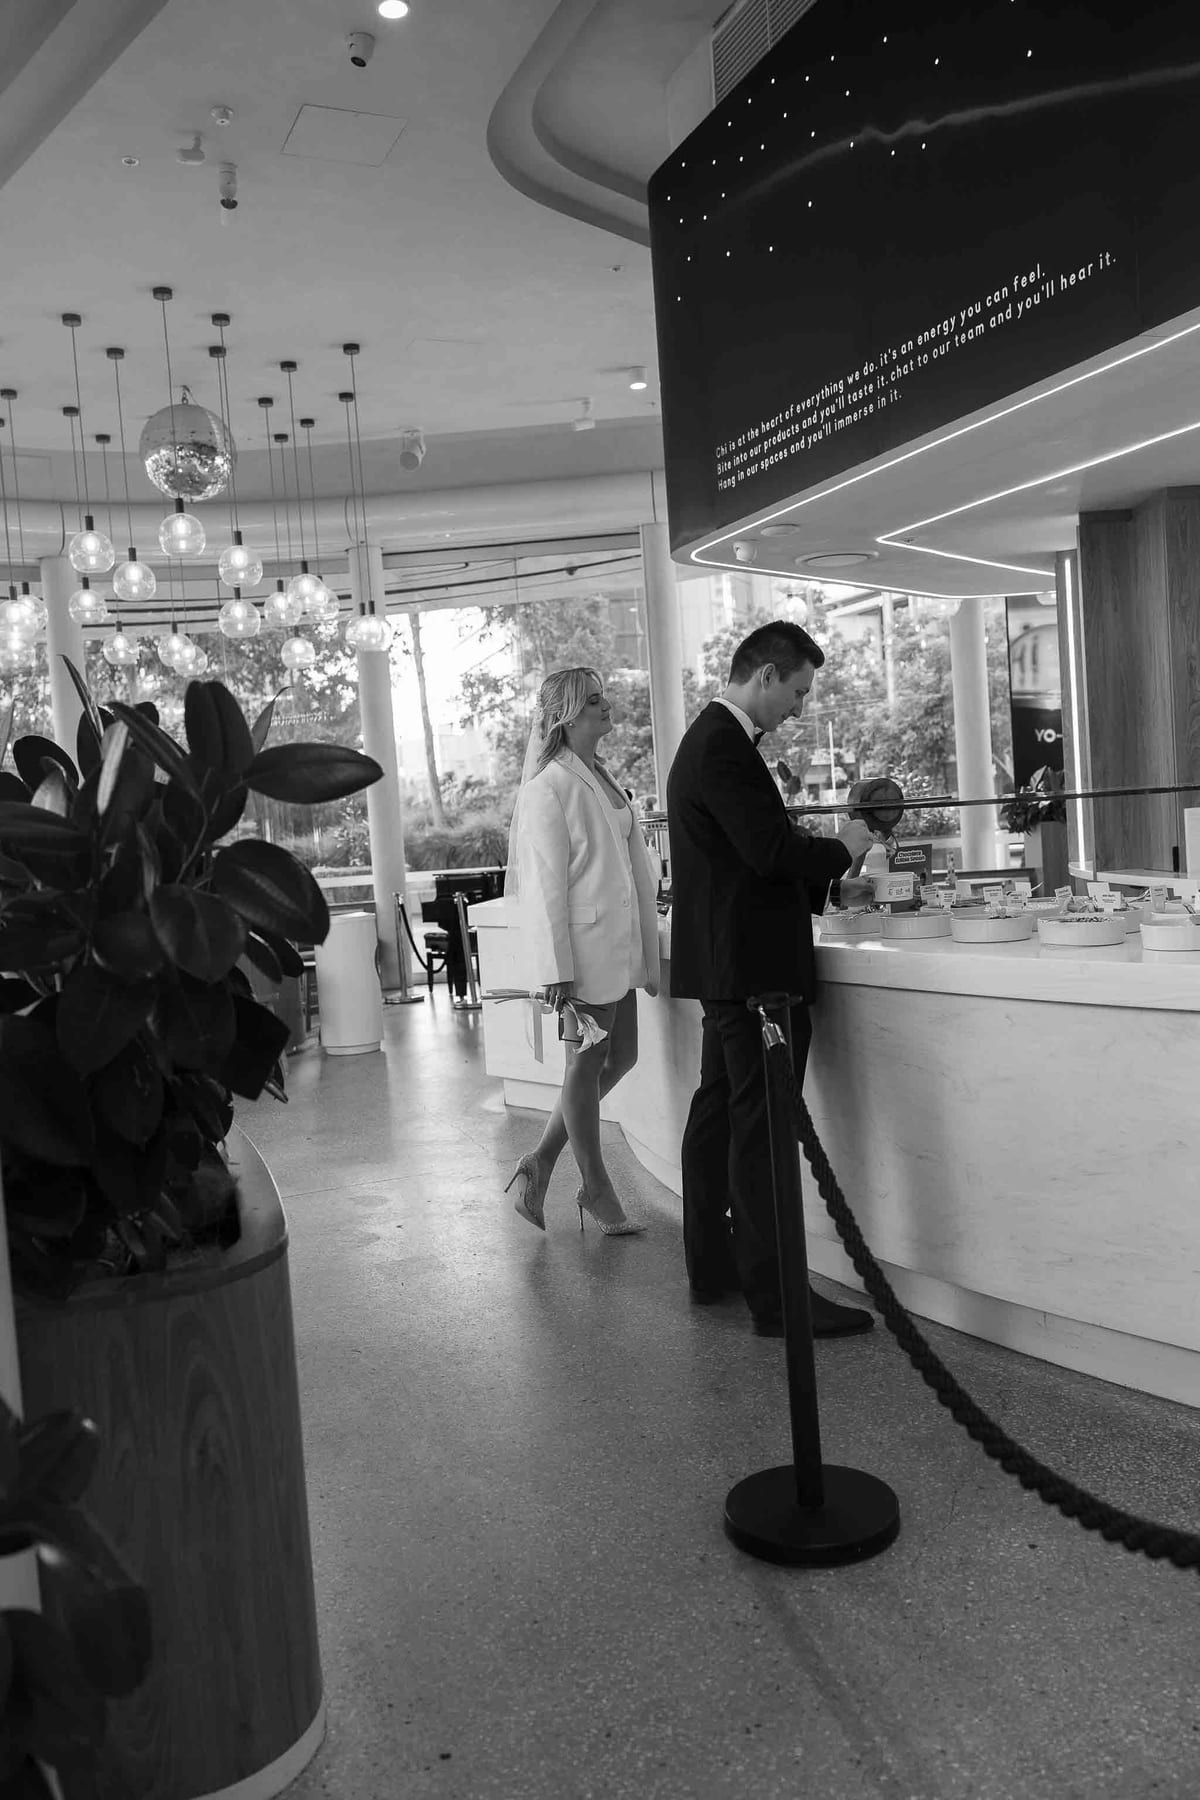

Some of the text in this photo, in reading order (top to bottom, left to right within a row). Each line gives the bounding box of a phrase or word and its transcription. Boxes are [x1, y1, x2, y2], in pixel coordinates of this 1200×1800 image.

[715, 263, 1046, 459] Chi is at the heart of everything we do. it's an energy you can feel.
[717, 251, 1116, 476] Bite into our products and you'll taste it. chat to our team and you'll hear it.
[717, 388, 902, 491] Hang in our spaces and you'll immerse in it.
